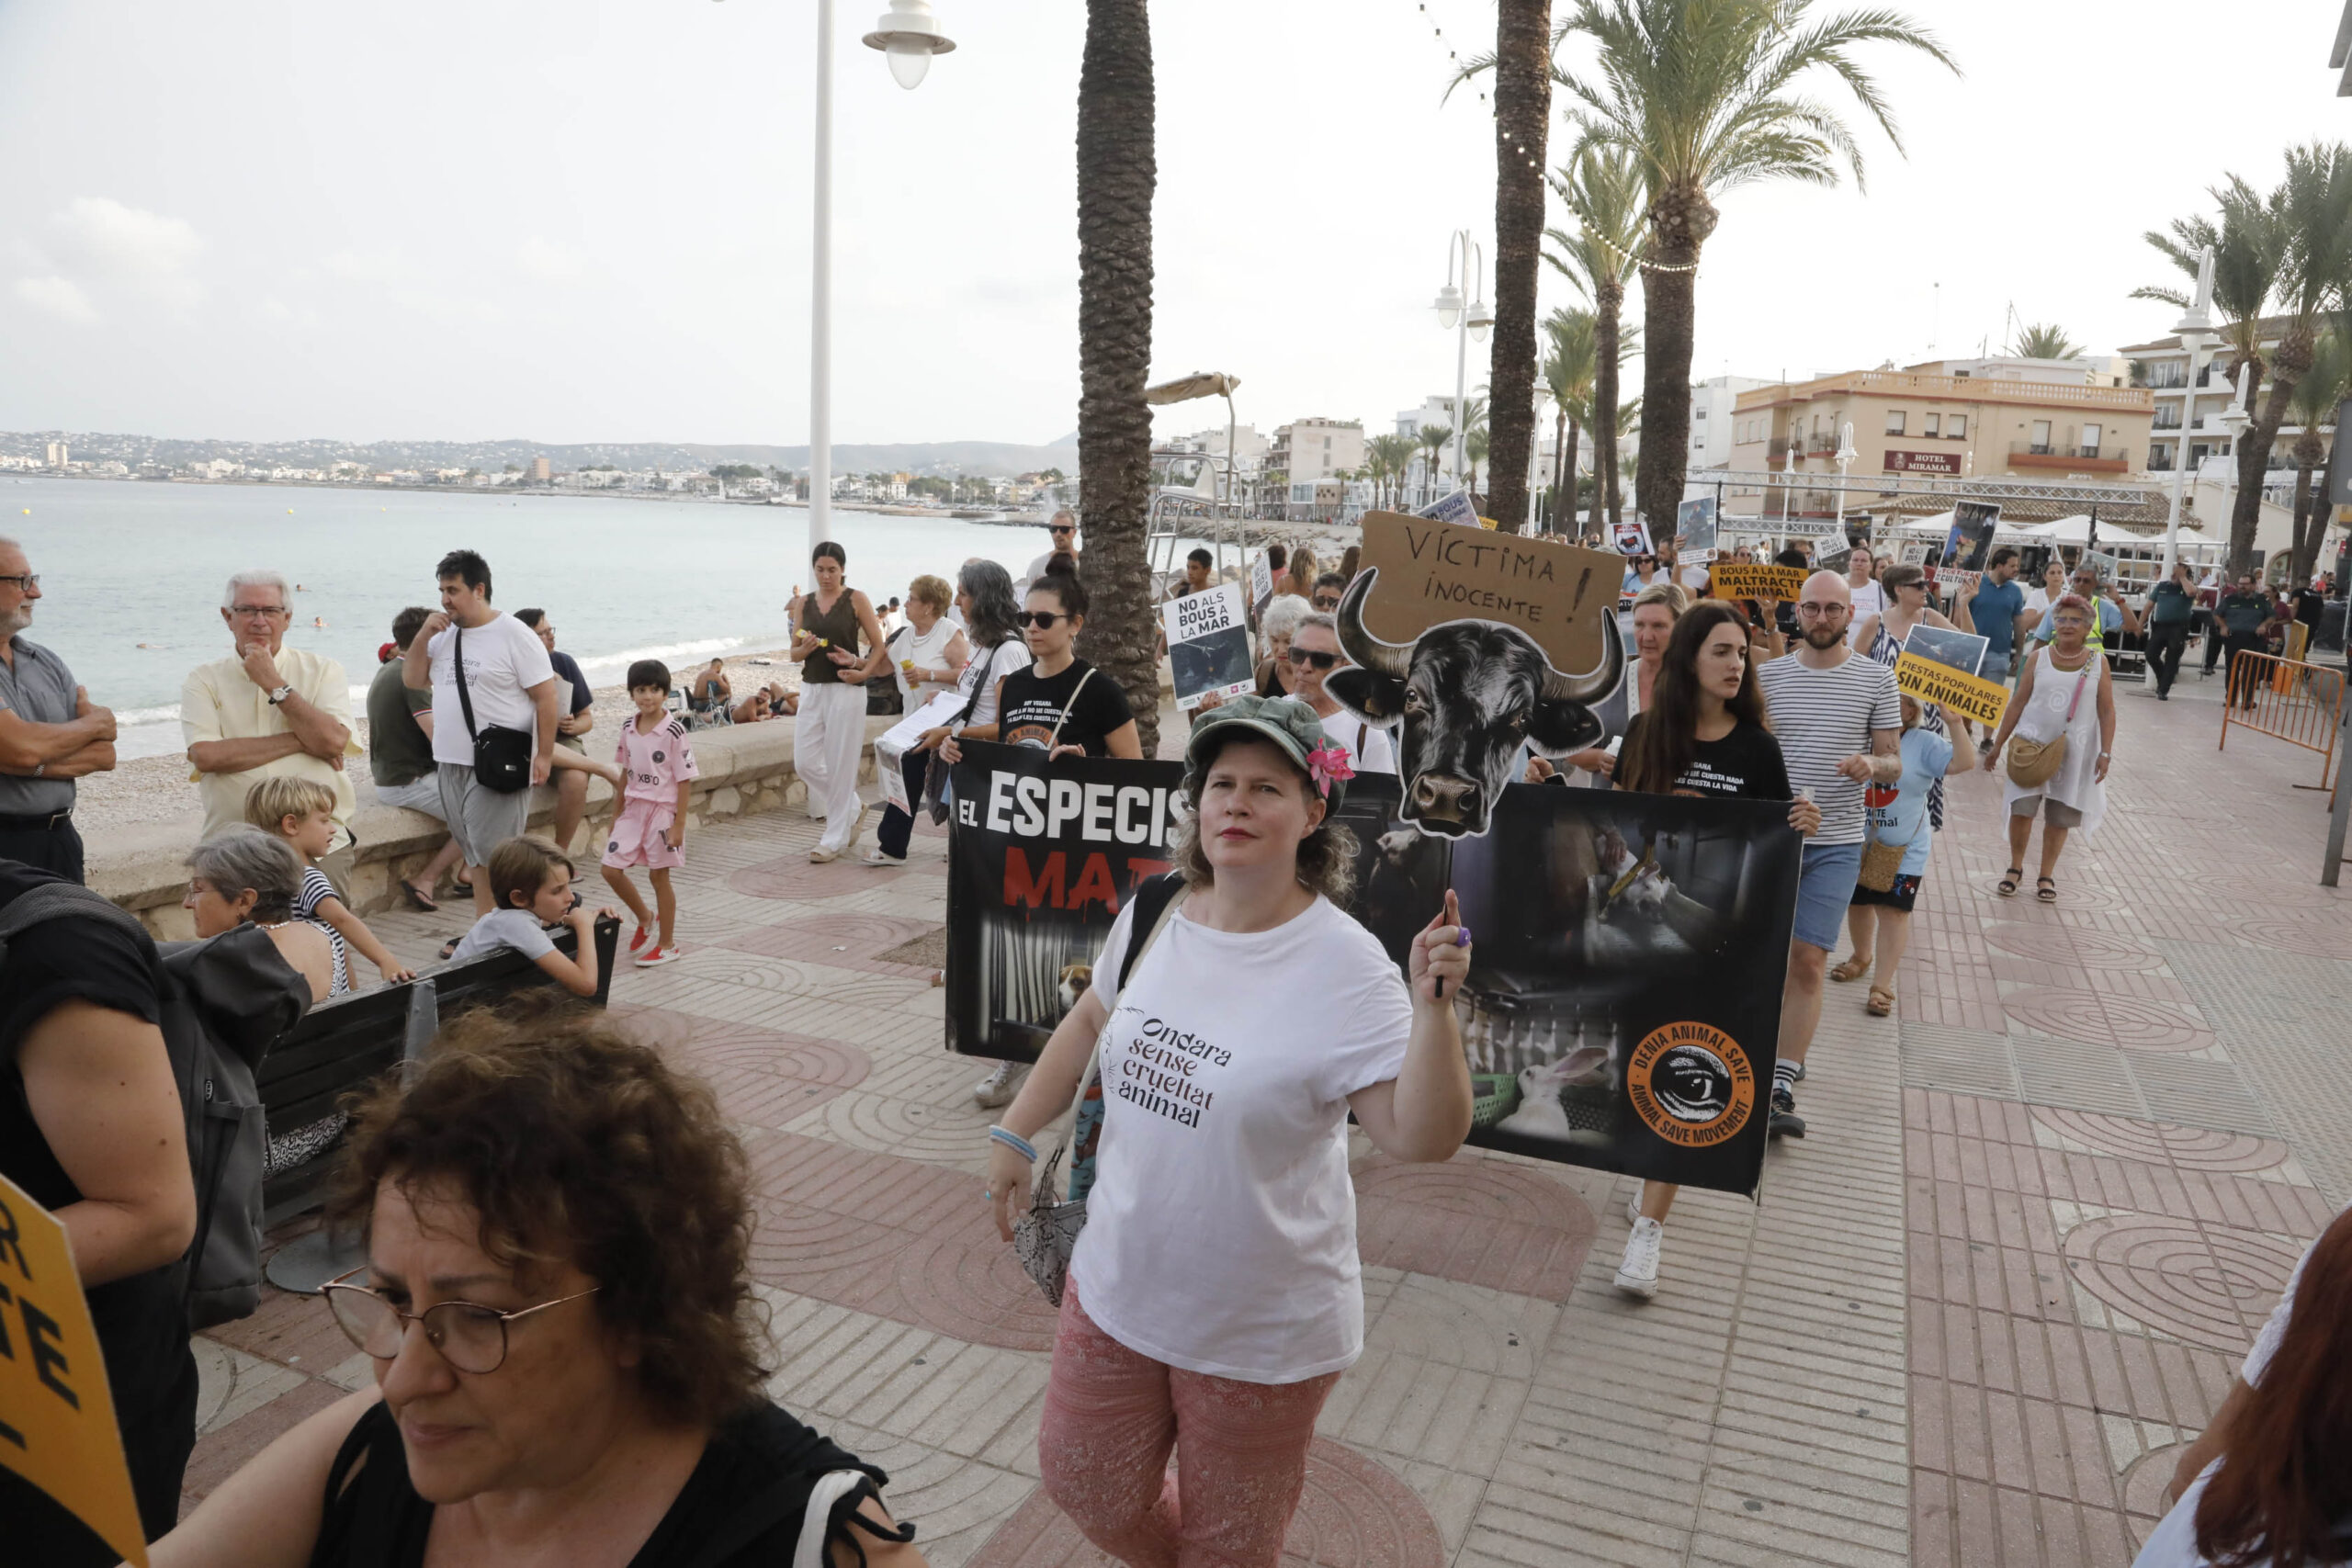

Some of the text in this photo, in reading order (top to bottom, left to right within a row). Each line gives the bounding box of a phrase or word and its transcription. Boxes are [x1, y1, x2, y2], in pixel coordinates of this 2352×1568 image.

[1907, 463, 1951, 472] MIRAMAR
[1915, 454, 1946, 463] HOTEL
[1438, 497, 1464, 515] BOUS
[1718, 577, 1804, 590] MALTRACTE
[1720, 567, 1749, 575] BOUS
[1752, 567, 1758, 575] A
[1777, 568, 1801, 578] MAR
[1178, 592, 1225, 614] NO ALS
[1735, 587, 1793, 598] ANIMAL
[1179, 604, 1227, 626] BOUS A
[1181, 615, 1229, 639] LA MAR
[1901, 660, 2003, 705] FIESTAS POPULARES
[1898, 671, 1997, 720] SIN ANIMALES
[1044, 708, 1062, 716] CUESTA
[1687, 779, 1711, 787] CUESTA
[1722, 784, 1737, 792] VIDA
[1702, 772, 1725, 783] CUESTA
[1726, 776, 1744, 784] NADA
[958, 799, 978, 828] EL
[986, 770, 1196, 850] ESPECIS
[1142, 1018, 1231, 1067] Ondara
[1635, 1025, 1751, 1083] DÉNIA ANIMAL SAVE
[1128, 1038, 1198, 1077] sense
[1123, 1060, 1215, 1110] crueltat
[1119, 1080, 1200, 1128] animal
[1632, 1083, 1749, 1143] ANIMAL SAVE MOVEMENT
